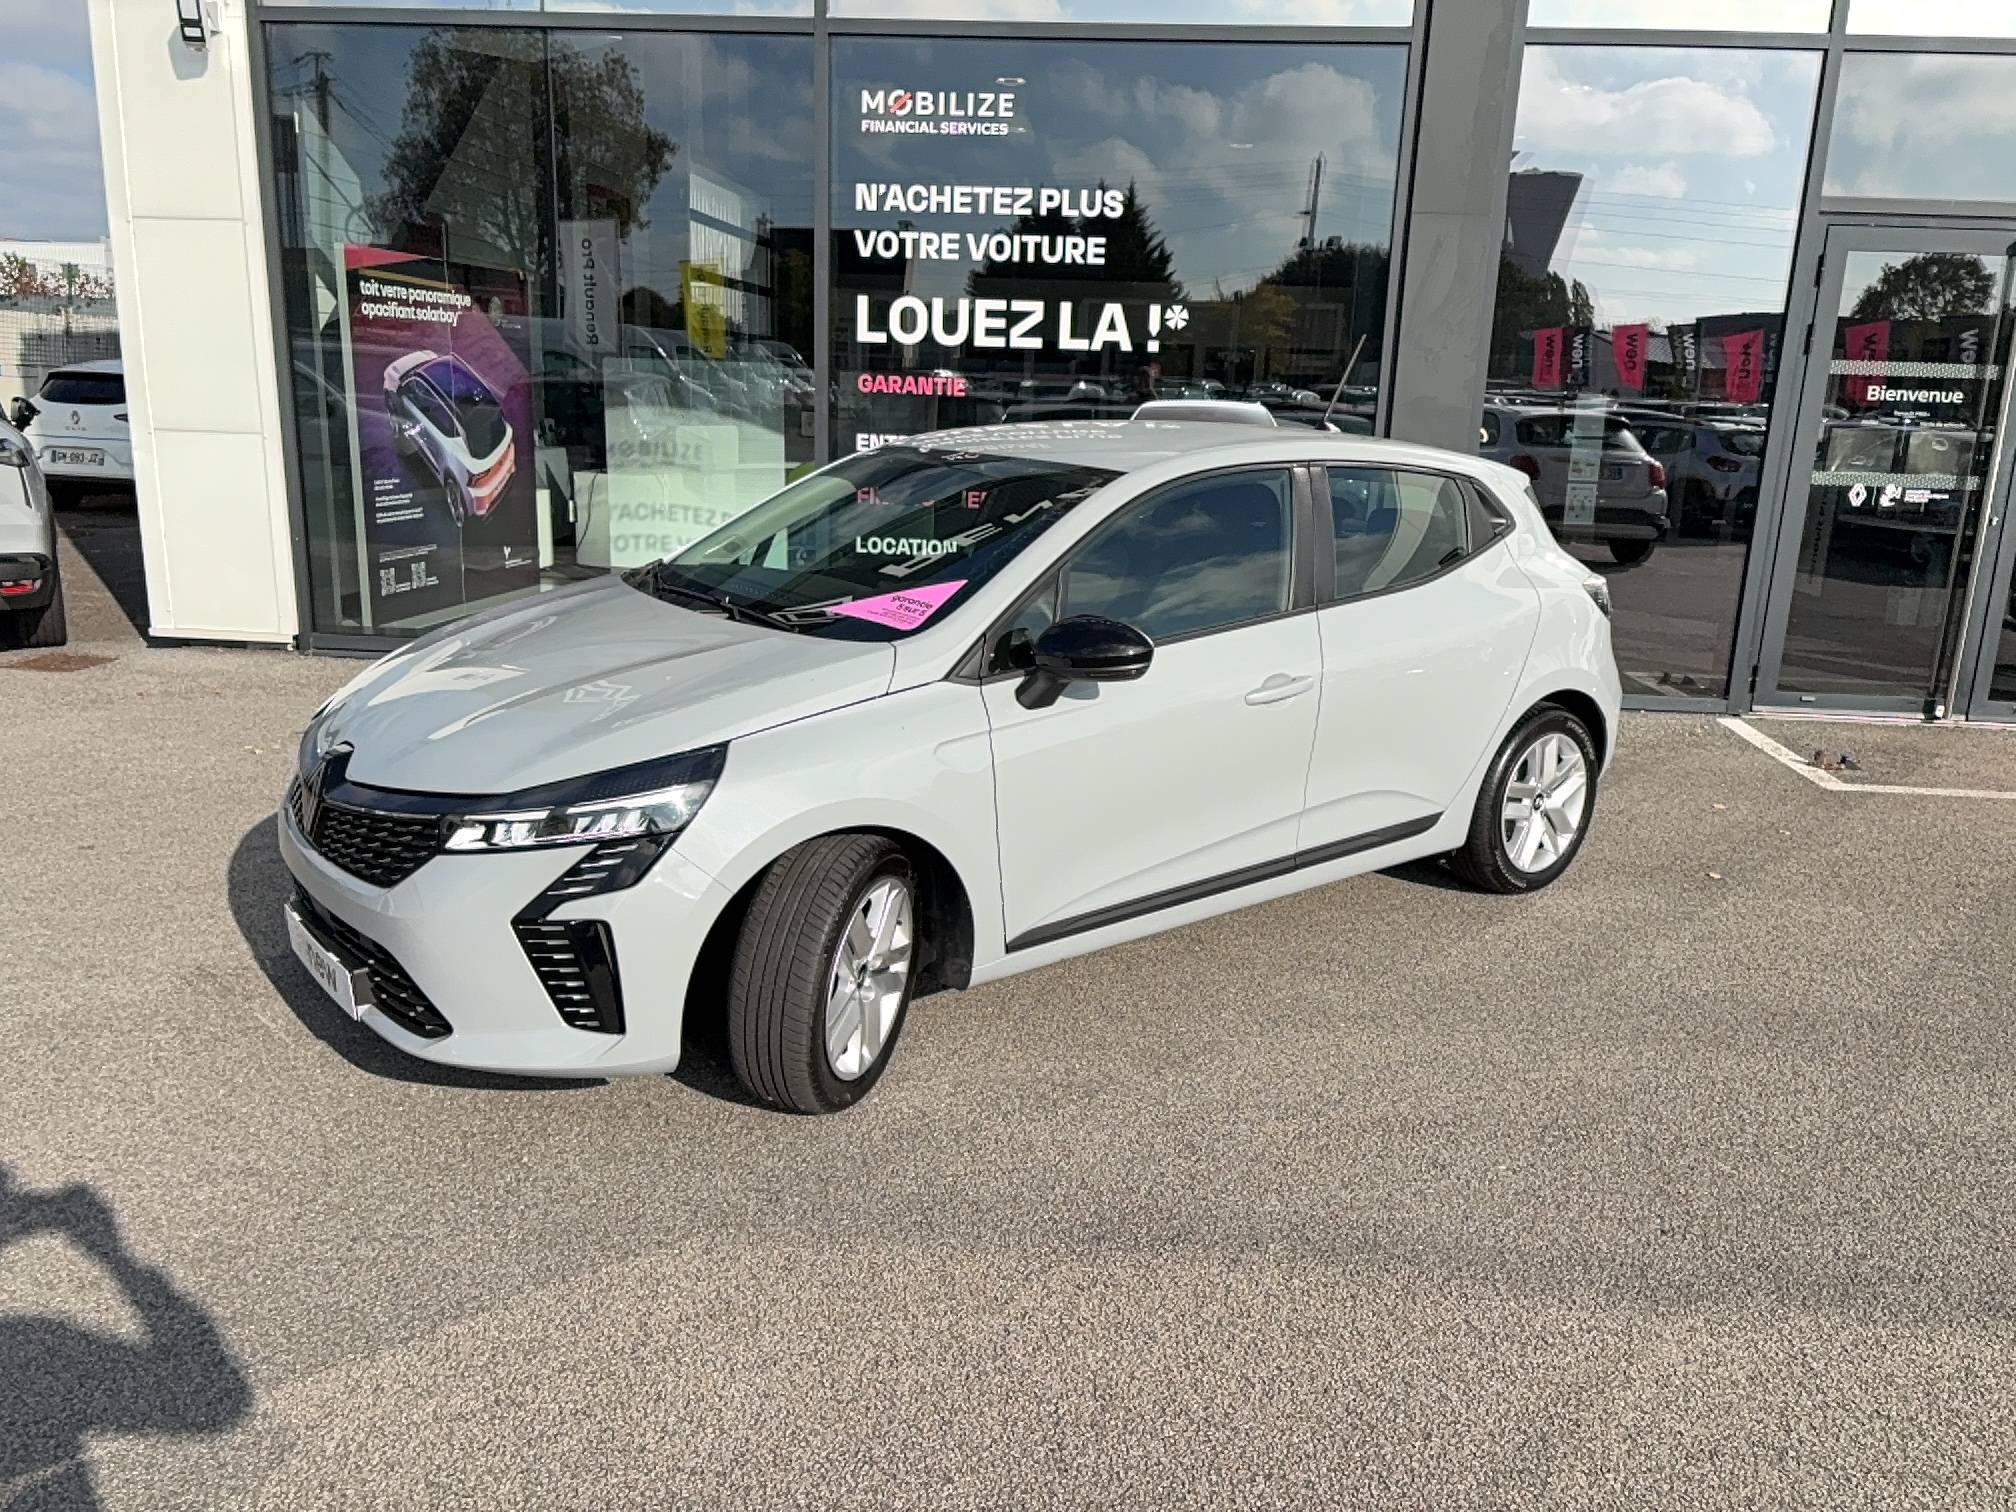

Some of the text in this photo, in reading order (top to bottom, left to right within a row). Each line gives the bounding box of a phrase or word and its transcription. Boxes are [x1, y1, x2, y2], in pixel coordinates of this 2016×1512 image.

[861, 89, 1015, 117] MOBILIZE
[861, 119, 1009, 136] FINANCIAL SERVICES
[854, 183, 1125, 219] N'ACHETEZ PLUS
[854, 230, 1107, 266] VOTRE VOITURE
[360, 279, 472, 309] toit verre panoramique
[361, 301, 416, 319] opacifiant
[856, 294, 1046, 350] LOUEZ
[1057, 301, 1133, 352] LA
[857, 373, 967, 397] GARANTIE
[1866, 385, 1964, 404] Bienvenue
[855, 536, 958, 556] LOCATION
